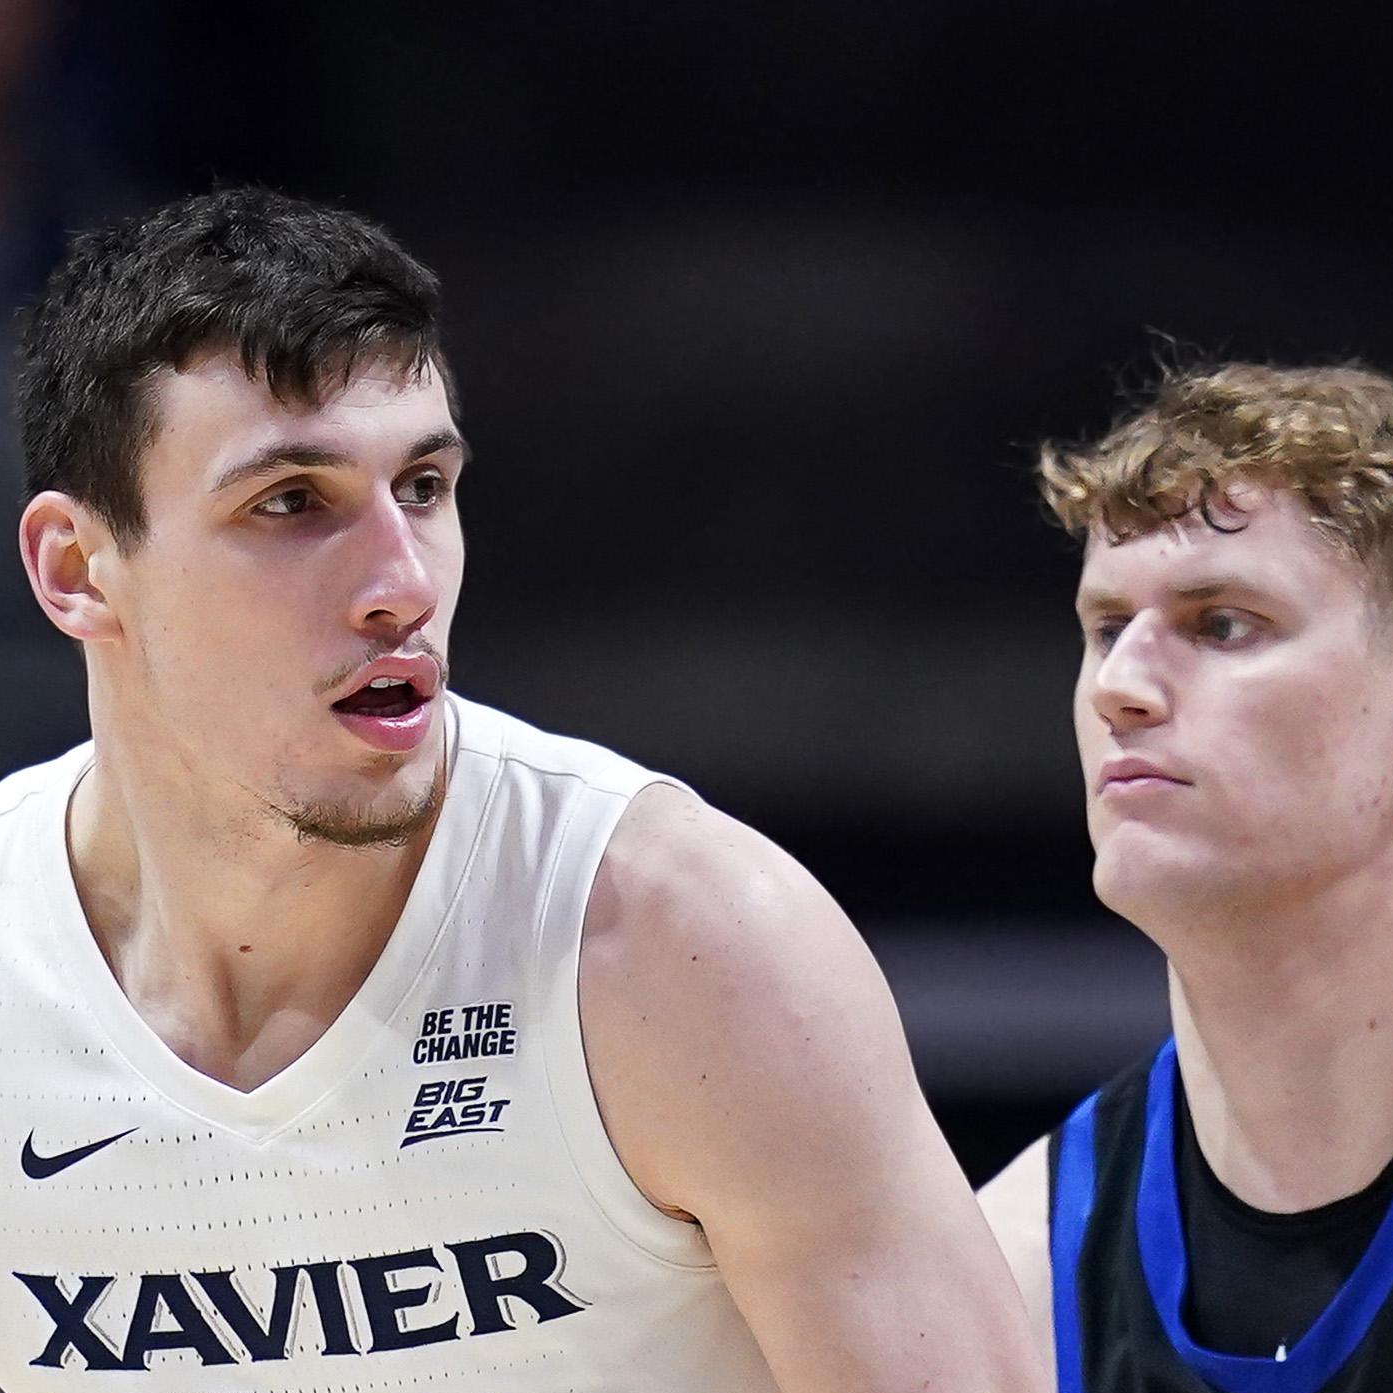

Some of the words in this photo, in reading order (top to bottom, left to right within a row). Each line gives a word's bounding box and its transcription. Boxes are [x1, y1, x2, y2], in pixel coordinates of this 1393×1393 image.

[421, 1009, 454, 1036] BE
[462, 1003, 512, 1032] THE
[413, 1030, 517, 1064] CHANGE
[413, 1076, 487, 1107] BIG
[405, 1099, 511, 1133] EAST
[12, 1230, 592, 1371] XAVIER
